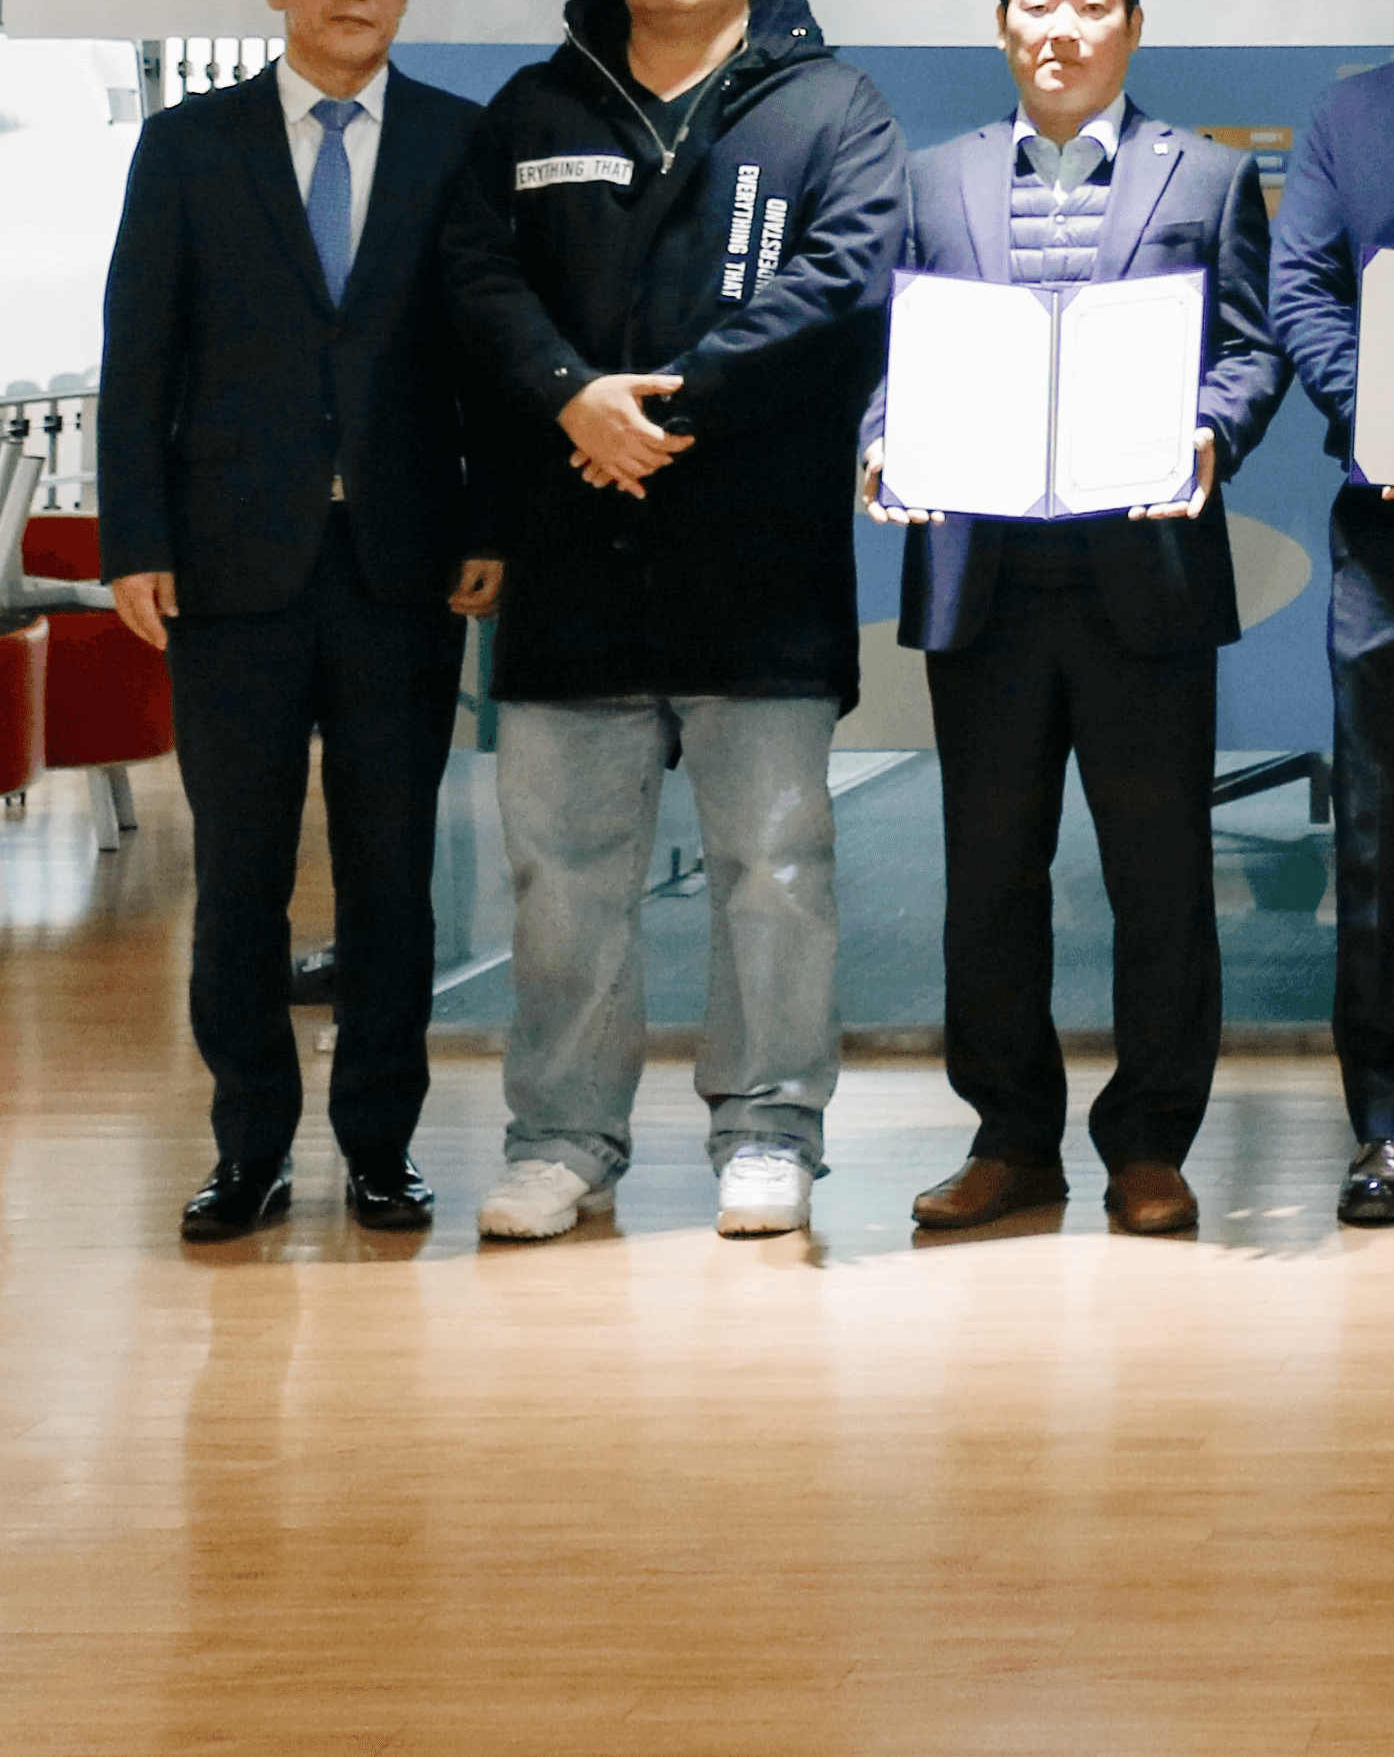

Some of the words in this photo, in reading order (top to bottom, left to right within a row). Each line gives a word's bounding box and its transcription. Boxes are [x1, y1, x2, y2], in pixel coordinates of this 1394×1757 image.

[593, 159, 630, 179] THAT
[727, 164, 760, 255] EVERYTHING
[754, 198, 789, 295] NDERSTAND
[721, 261, 746, 300] THAT
